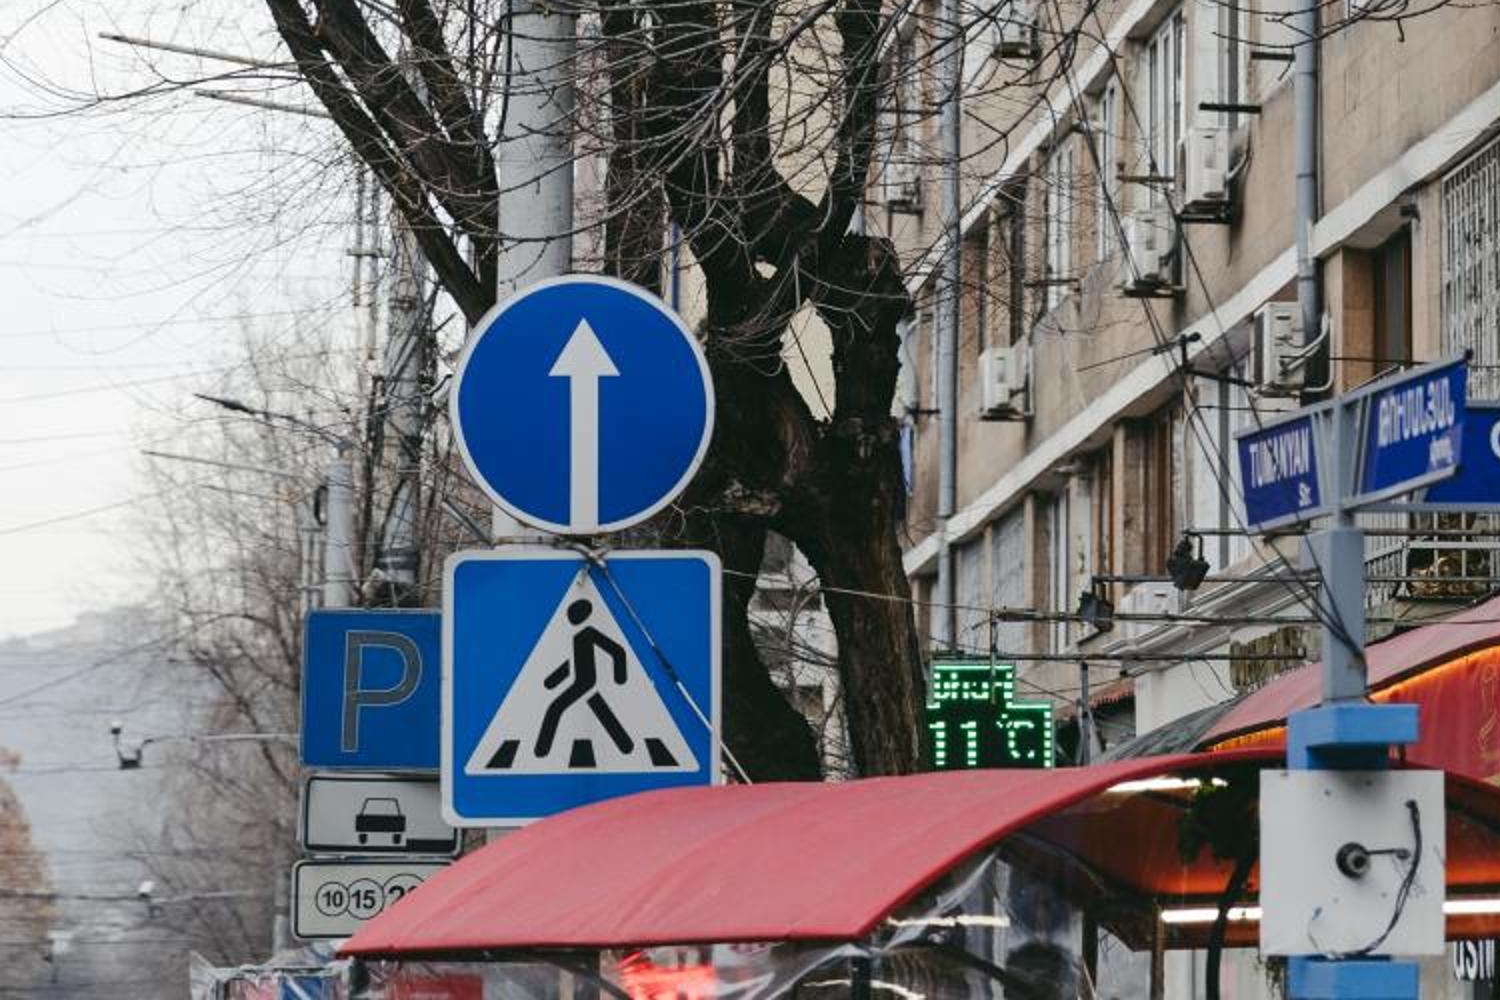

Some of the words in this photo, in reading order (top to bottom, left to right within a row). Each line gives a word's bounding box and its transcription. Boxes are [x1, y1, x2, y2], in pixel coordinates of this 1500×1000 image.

[341, 629, 424, 753] P
[322, 890, 343, 908] 10
[351, 889, 376, 910] 15
